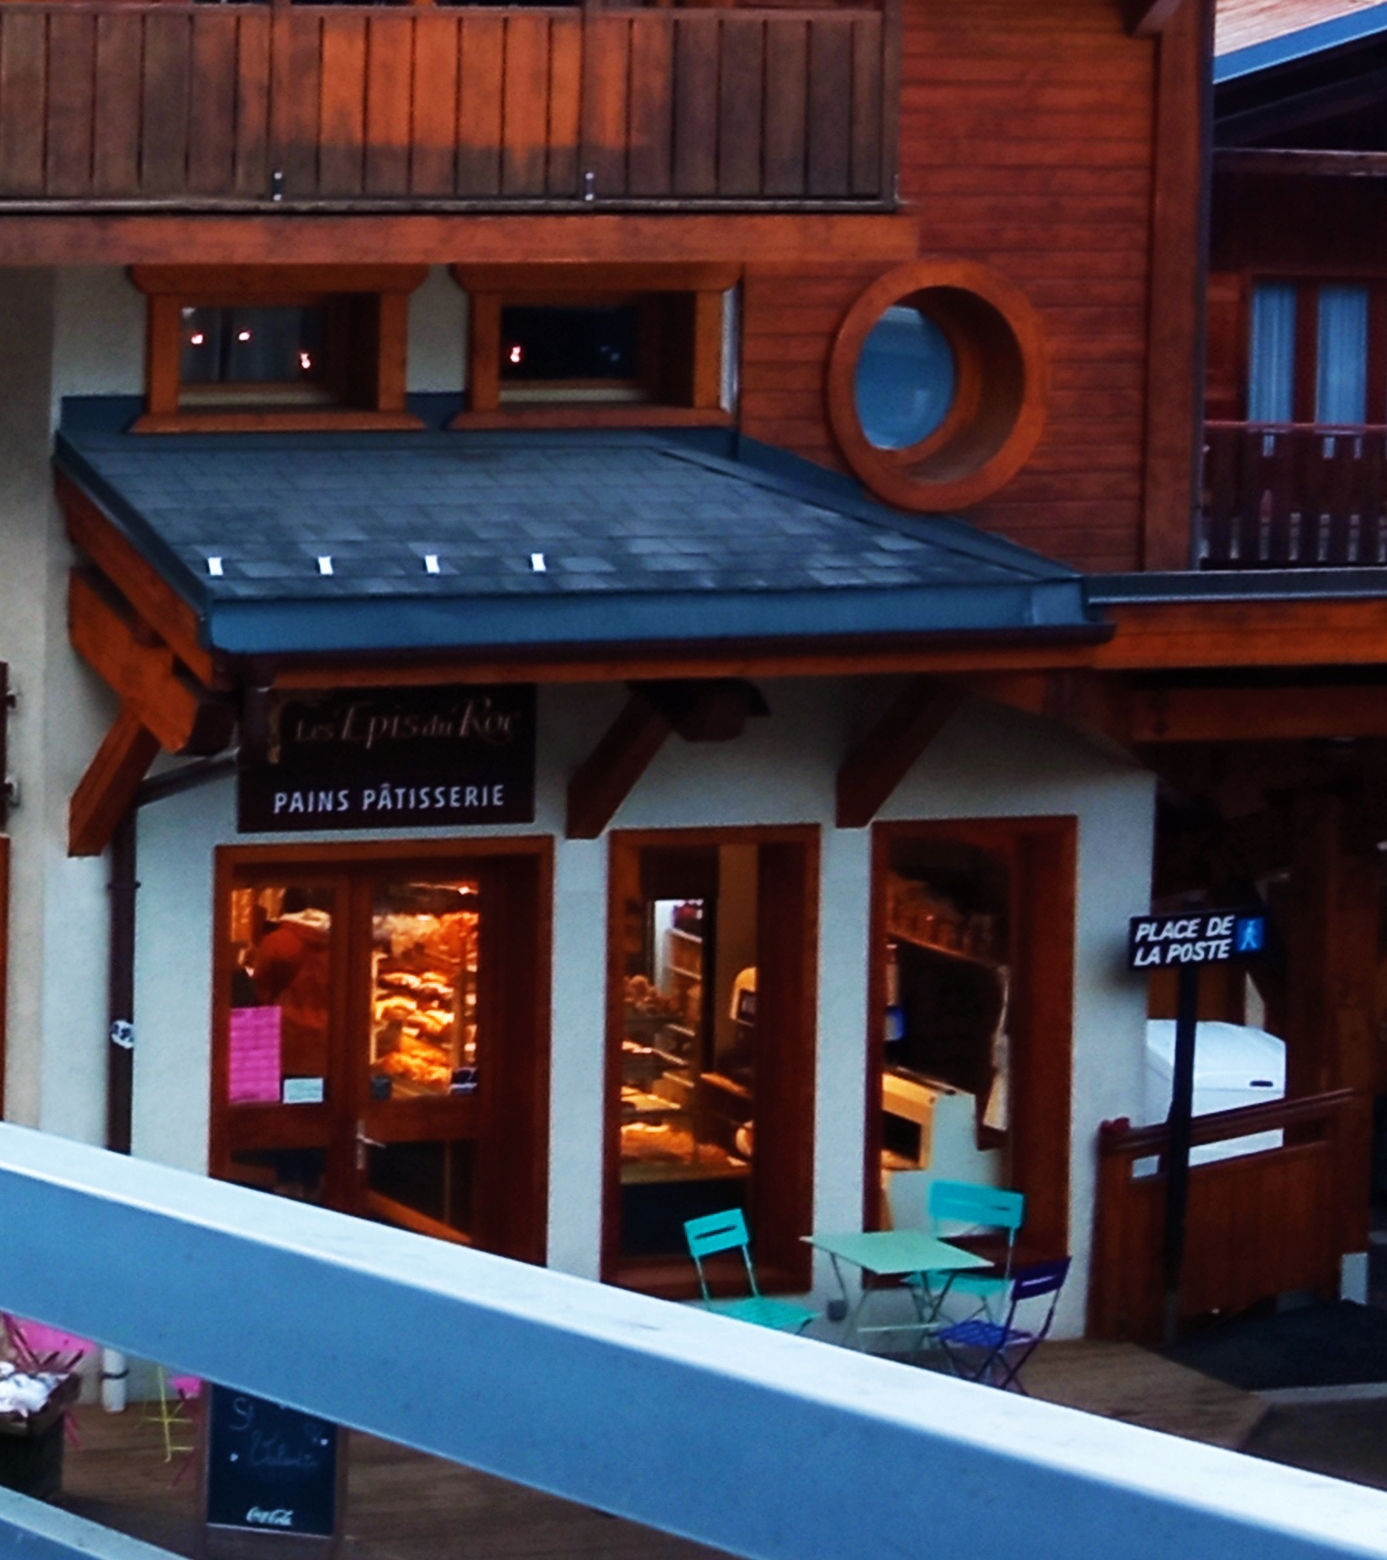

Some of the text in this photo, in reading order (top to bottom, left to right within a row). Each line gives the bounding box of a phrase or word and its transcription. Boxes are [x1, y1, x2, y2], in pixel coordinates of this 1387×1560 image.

[421, 714, 453, 738] du
[273, 783, 505, 814] PAINS PÂTISSERIE
[1135, 915, 1235, 943] PLACE DE
[1133, 938, 1233, 967] LA POSTE
